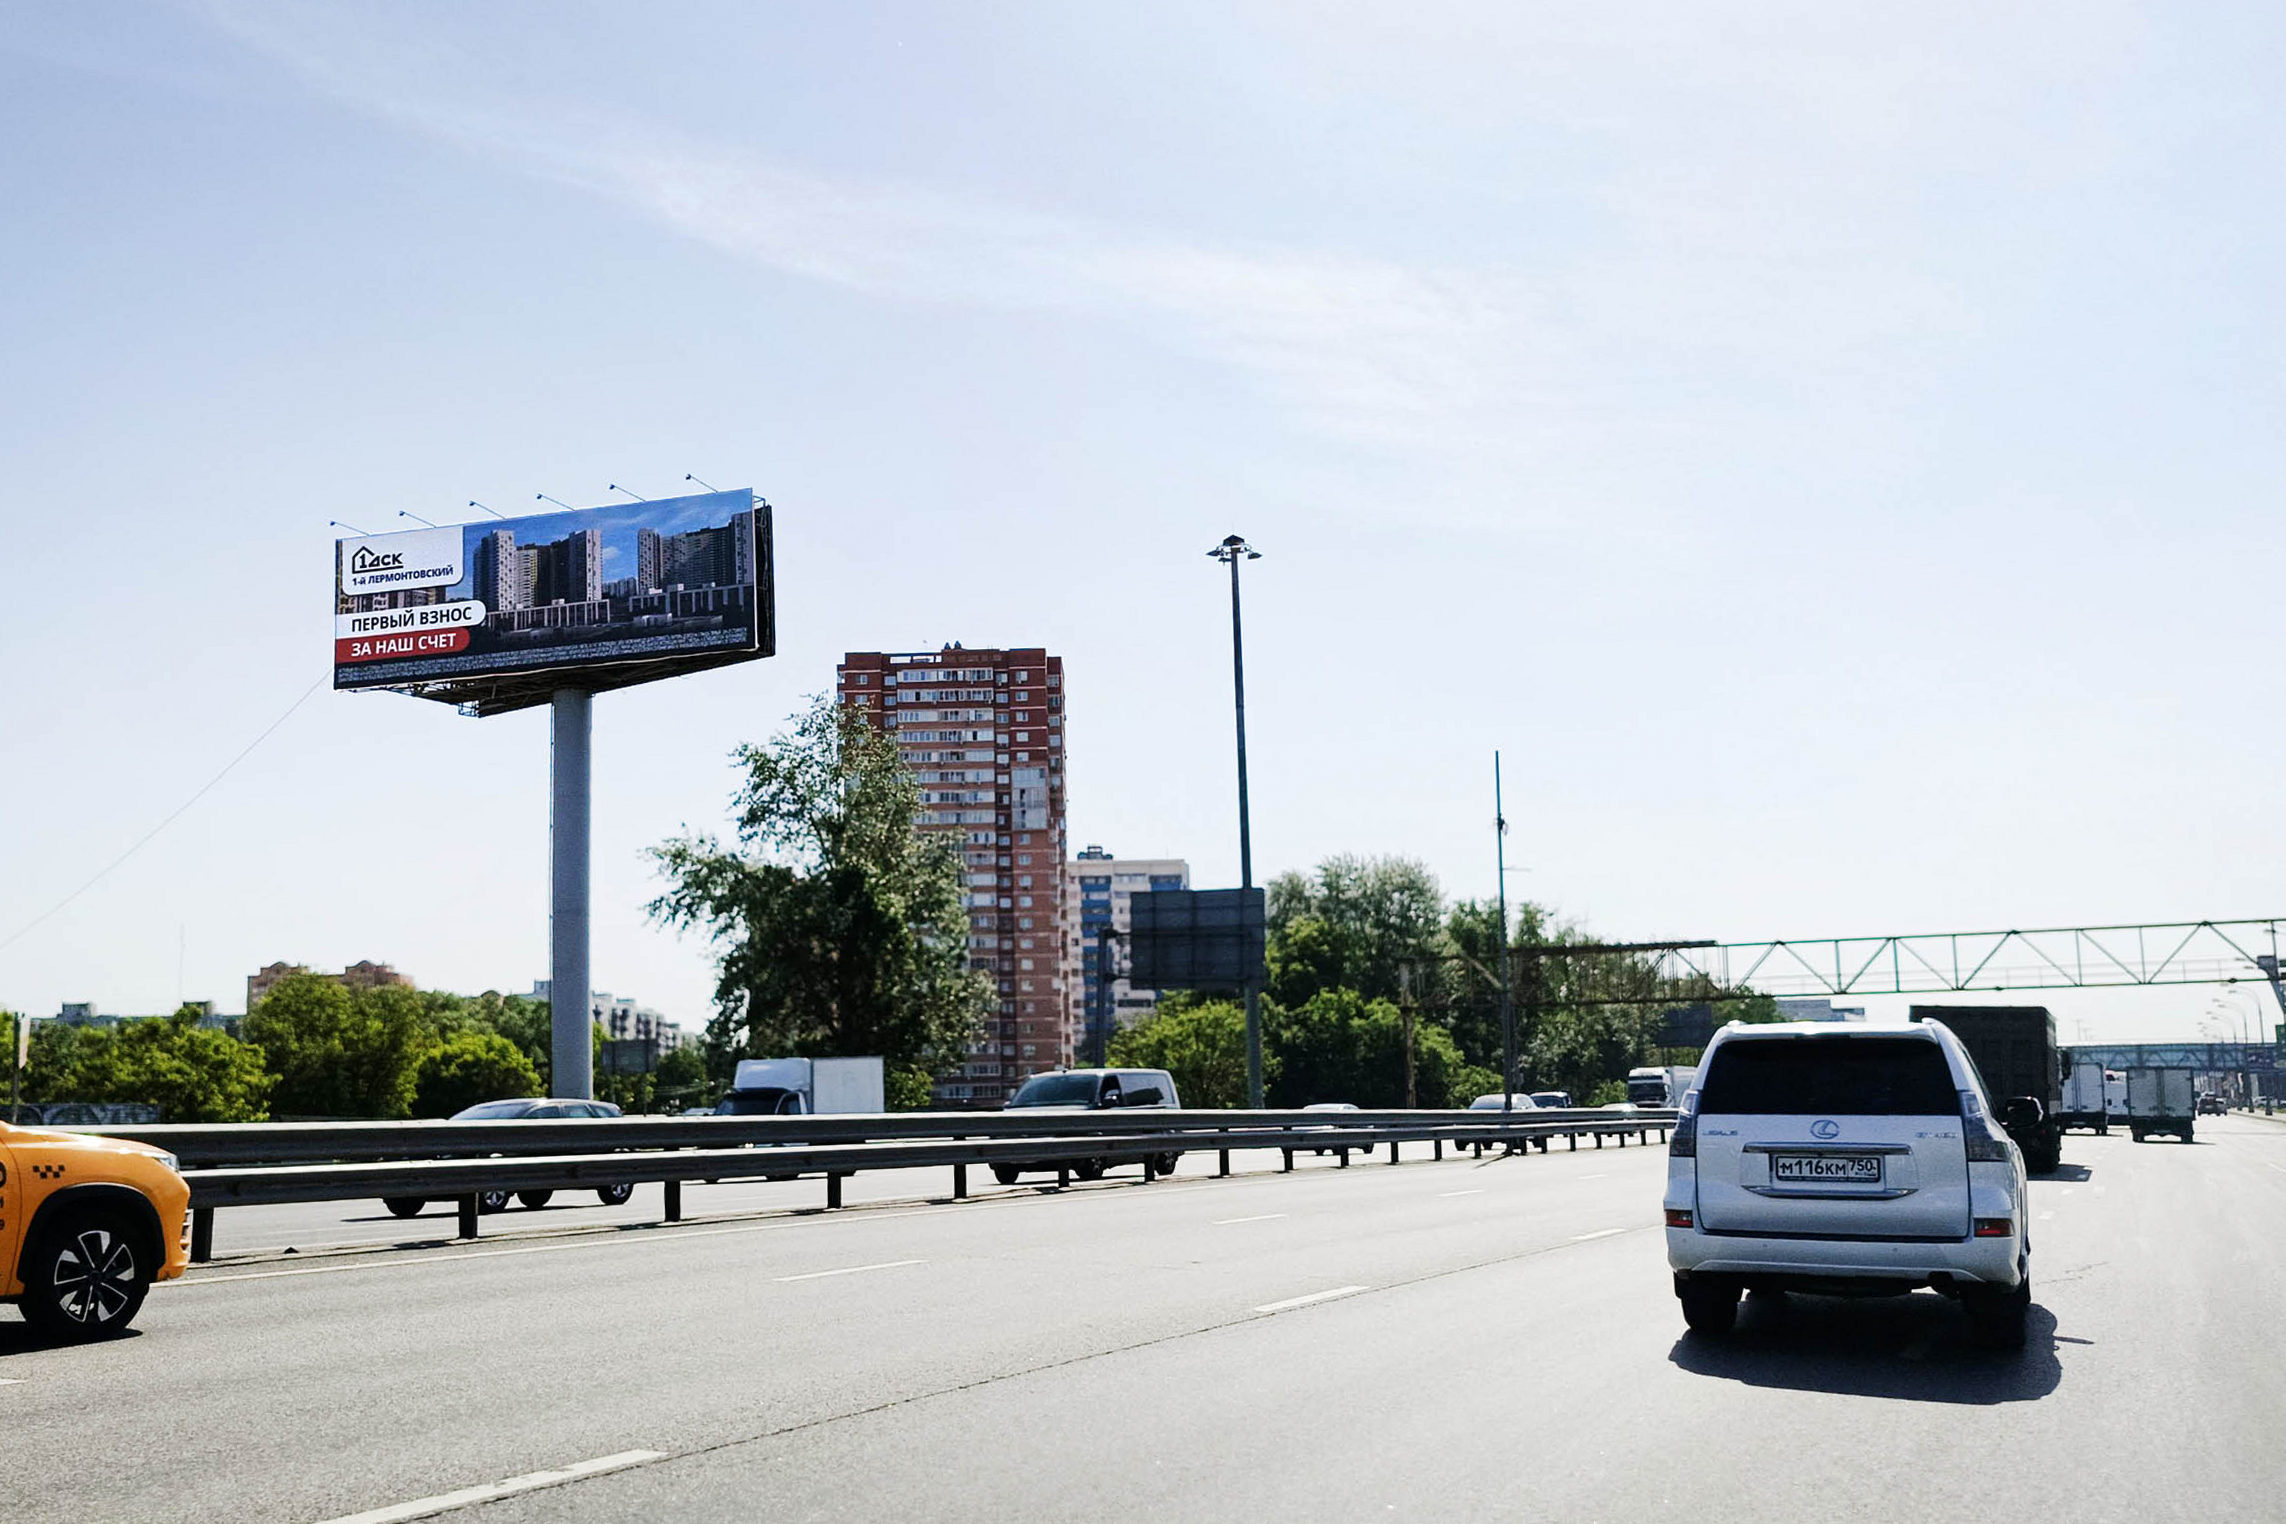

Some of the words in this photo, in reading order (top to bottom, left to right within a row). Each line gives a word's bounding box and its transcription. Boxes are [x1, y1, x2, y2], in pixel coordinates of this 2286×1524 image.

[368, 565, 453, 584] ЛЕРМОНТОВСКИЙ
[351, 609, 415, 632] ПЕРВЫЙ
[419, 606, 472, 625] ВЗНОС
[351, 642, 371, 657] ЗА
[375, 637, 413, 654] НАШ
[418, 633, 457, 650] СЧЕТ
[1848, 1159, 1873, 1172] 750
